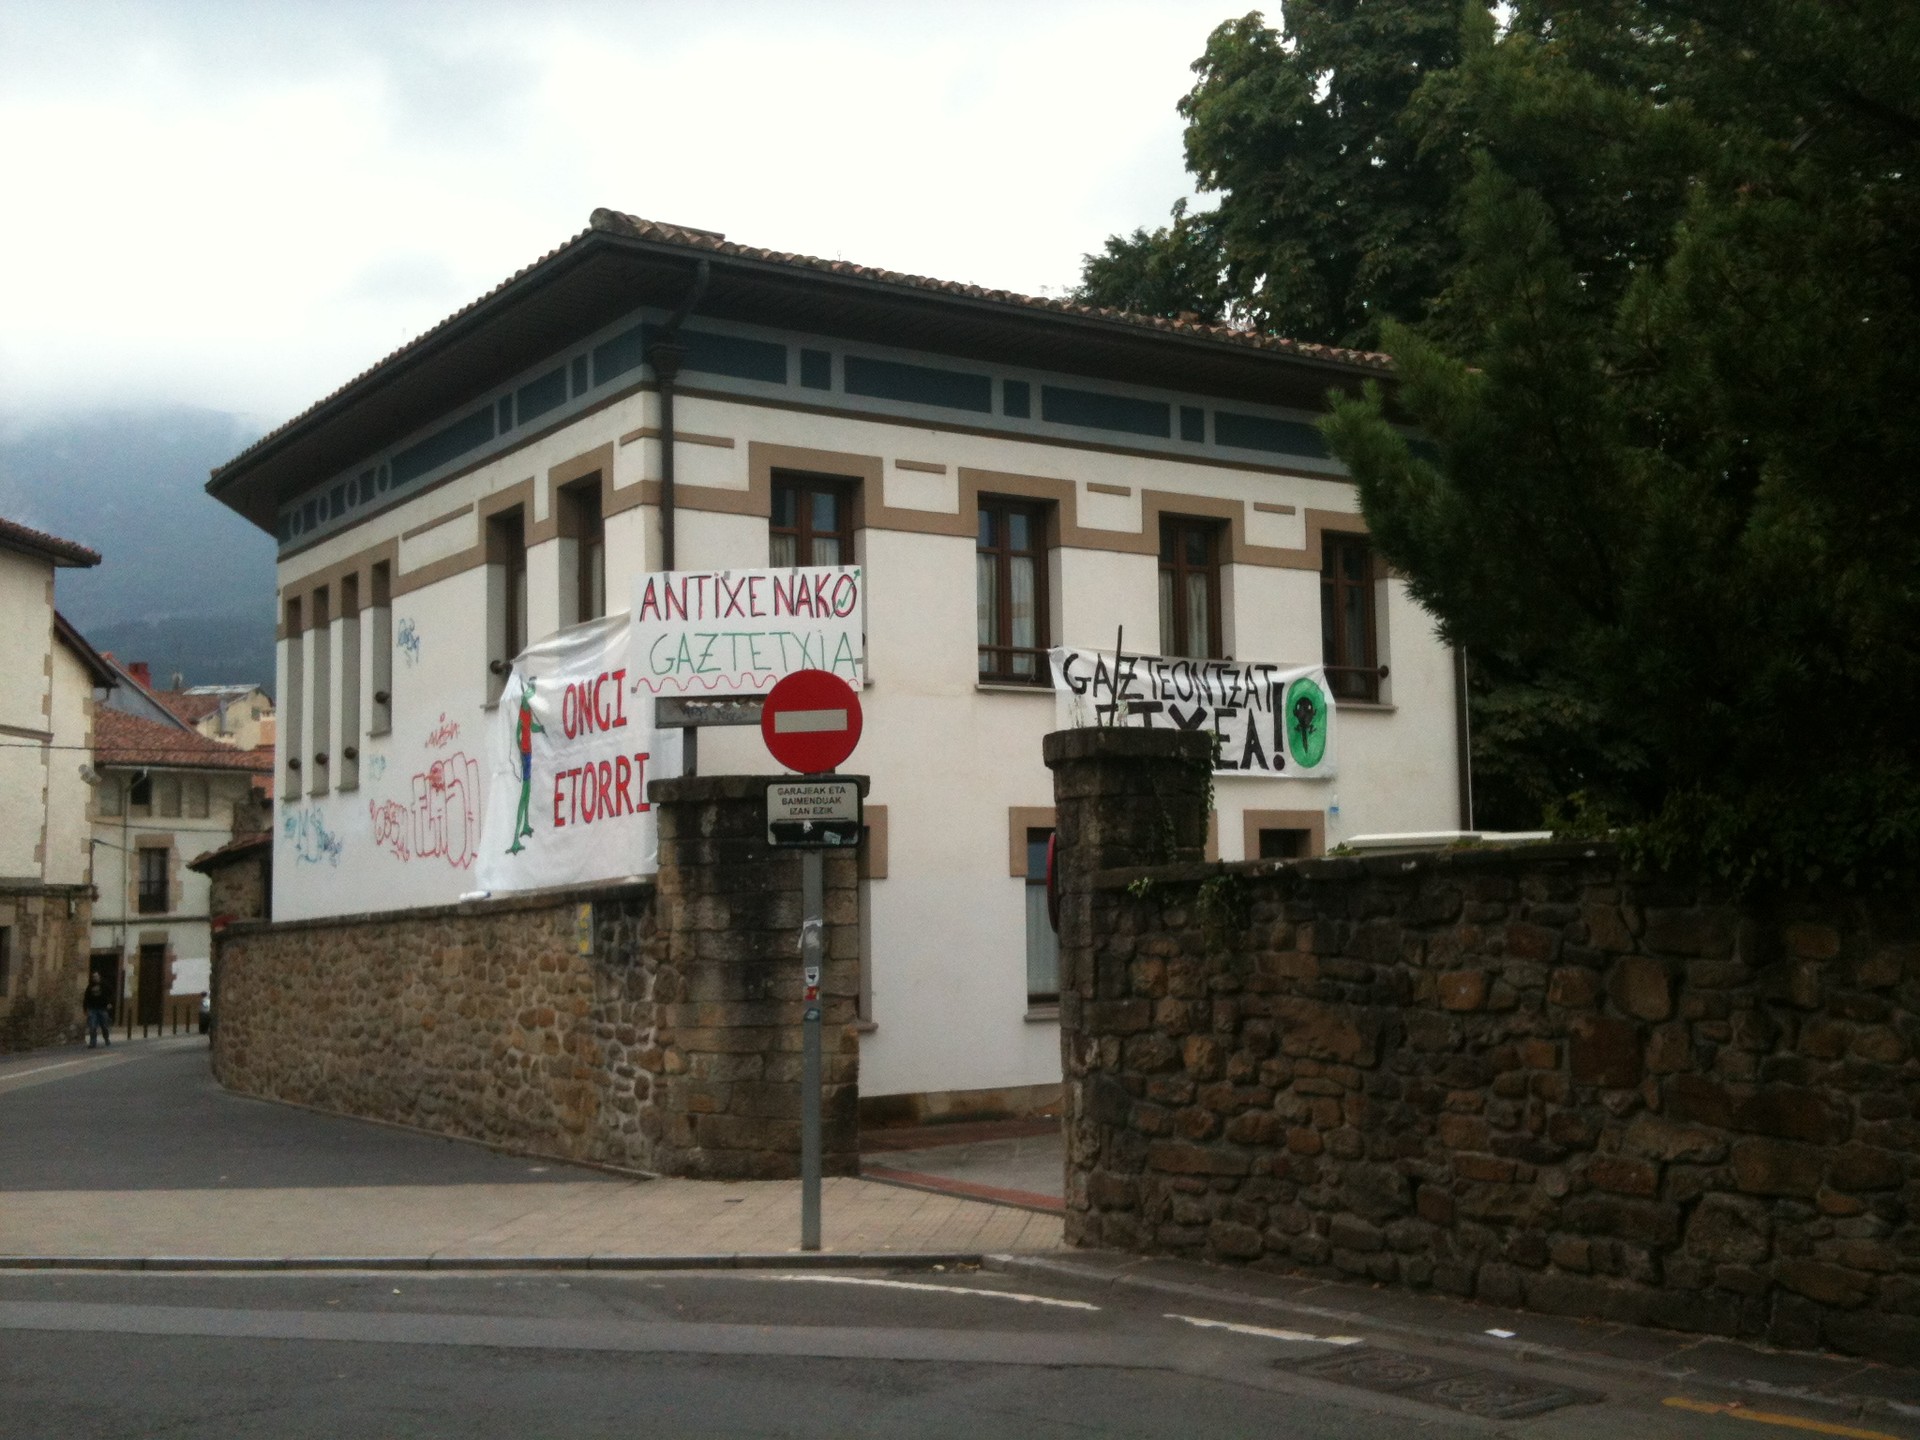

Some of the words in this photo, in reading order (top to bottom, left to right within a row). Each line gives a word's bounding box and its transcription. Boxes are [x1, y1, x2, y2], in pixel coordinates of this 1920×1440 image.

[1062, 652, 1278, 714] GAZTEONTZAT
[562, 668, 627, 740] ONGI
[554, 752, 651, 827] ETORRI
[777, 786, 826, 796] GARAJEAK
[828, 786, 846, 795] ETA
[781, 796, 842, 806] BAIMENDUAK
[789, 807, 810, 816] IZAN
[812, 806, 833, 815] EZIK
